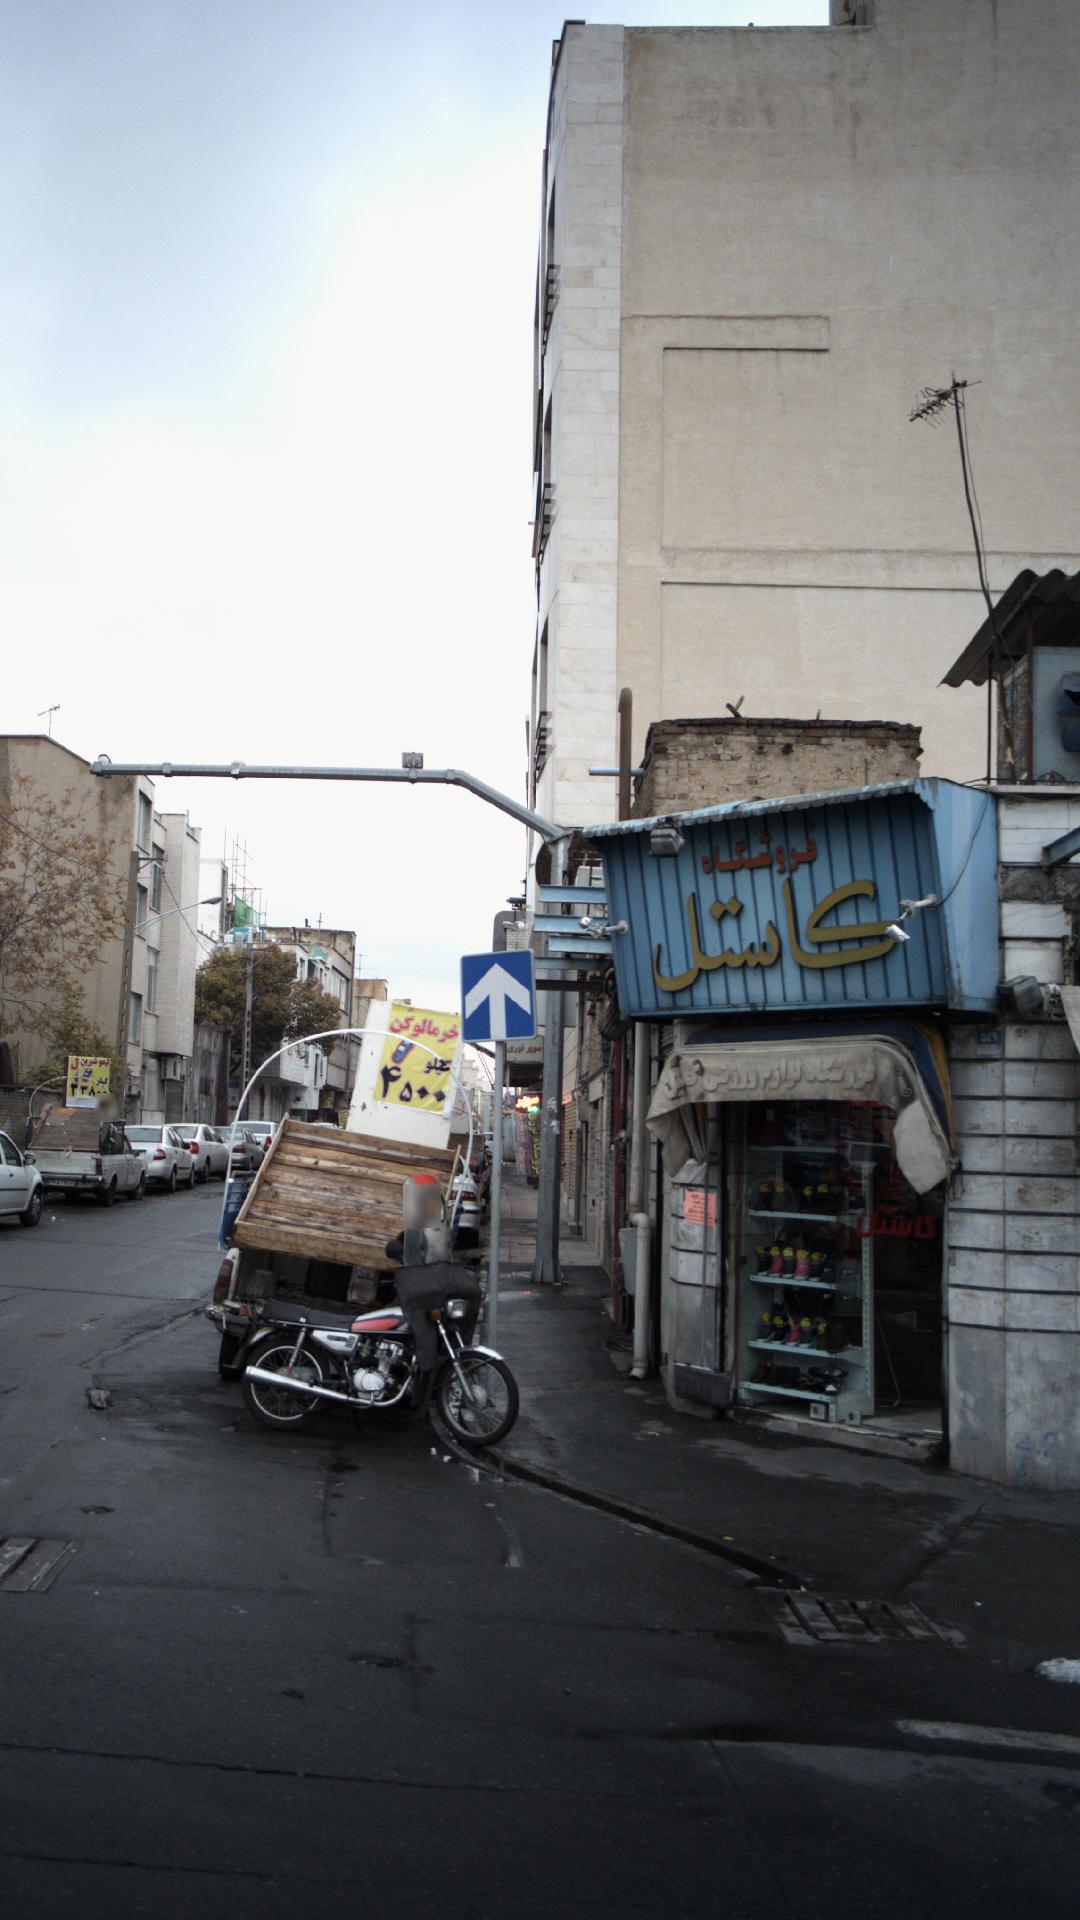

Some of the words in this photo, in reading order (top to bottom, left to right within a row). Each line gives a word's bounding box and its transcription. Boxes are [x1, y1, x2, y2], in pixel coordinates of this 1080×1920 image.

[701, 821, 817, 874] فروشگاه
[655, 878, 897, 991] کاستل
[380, 1065, 447, 1103] ۴۵۰۰
